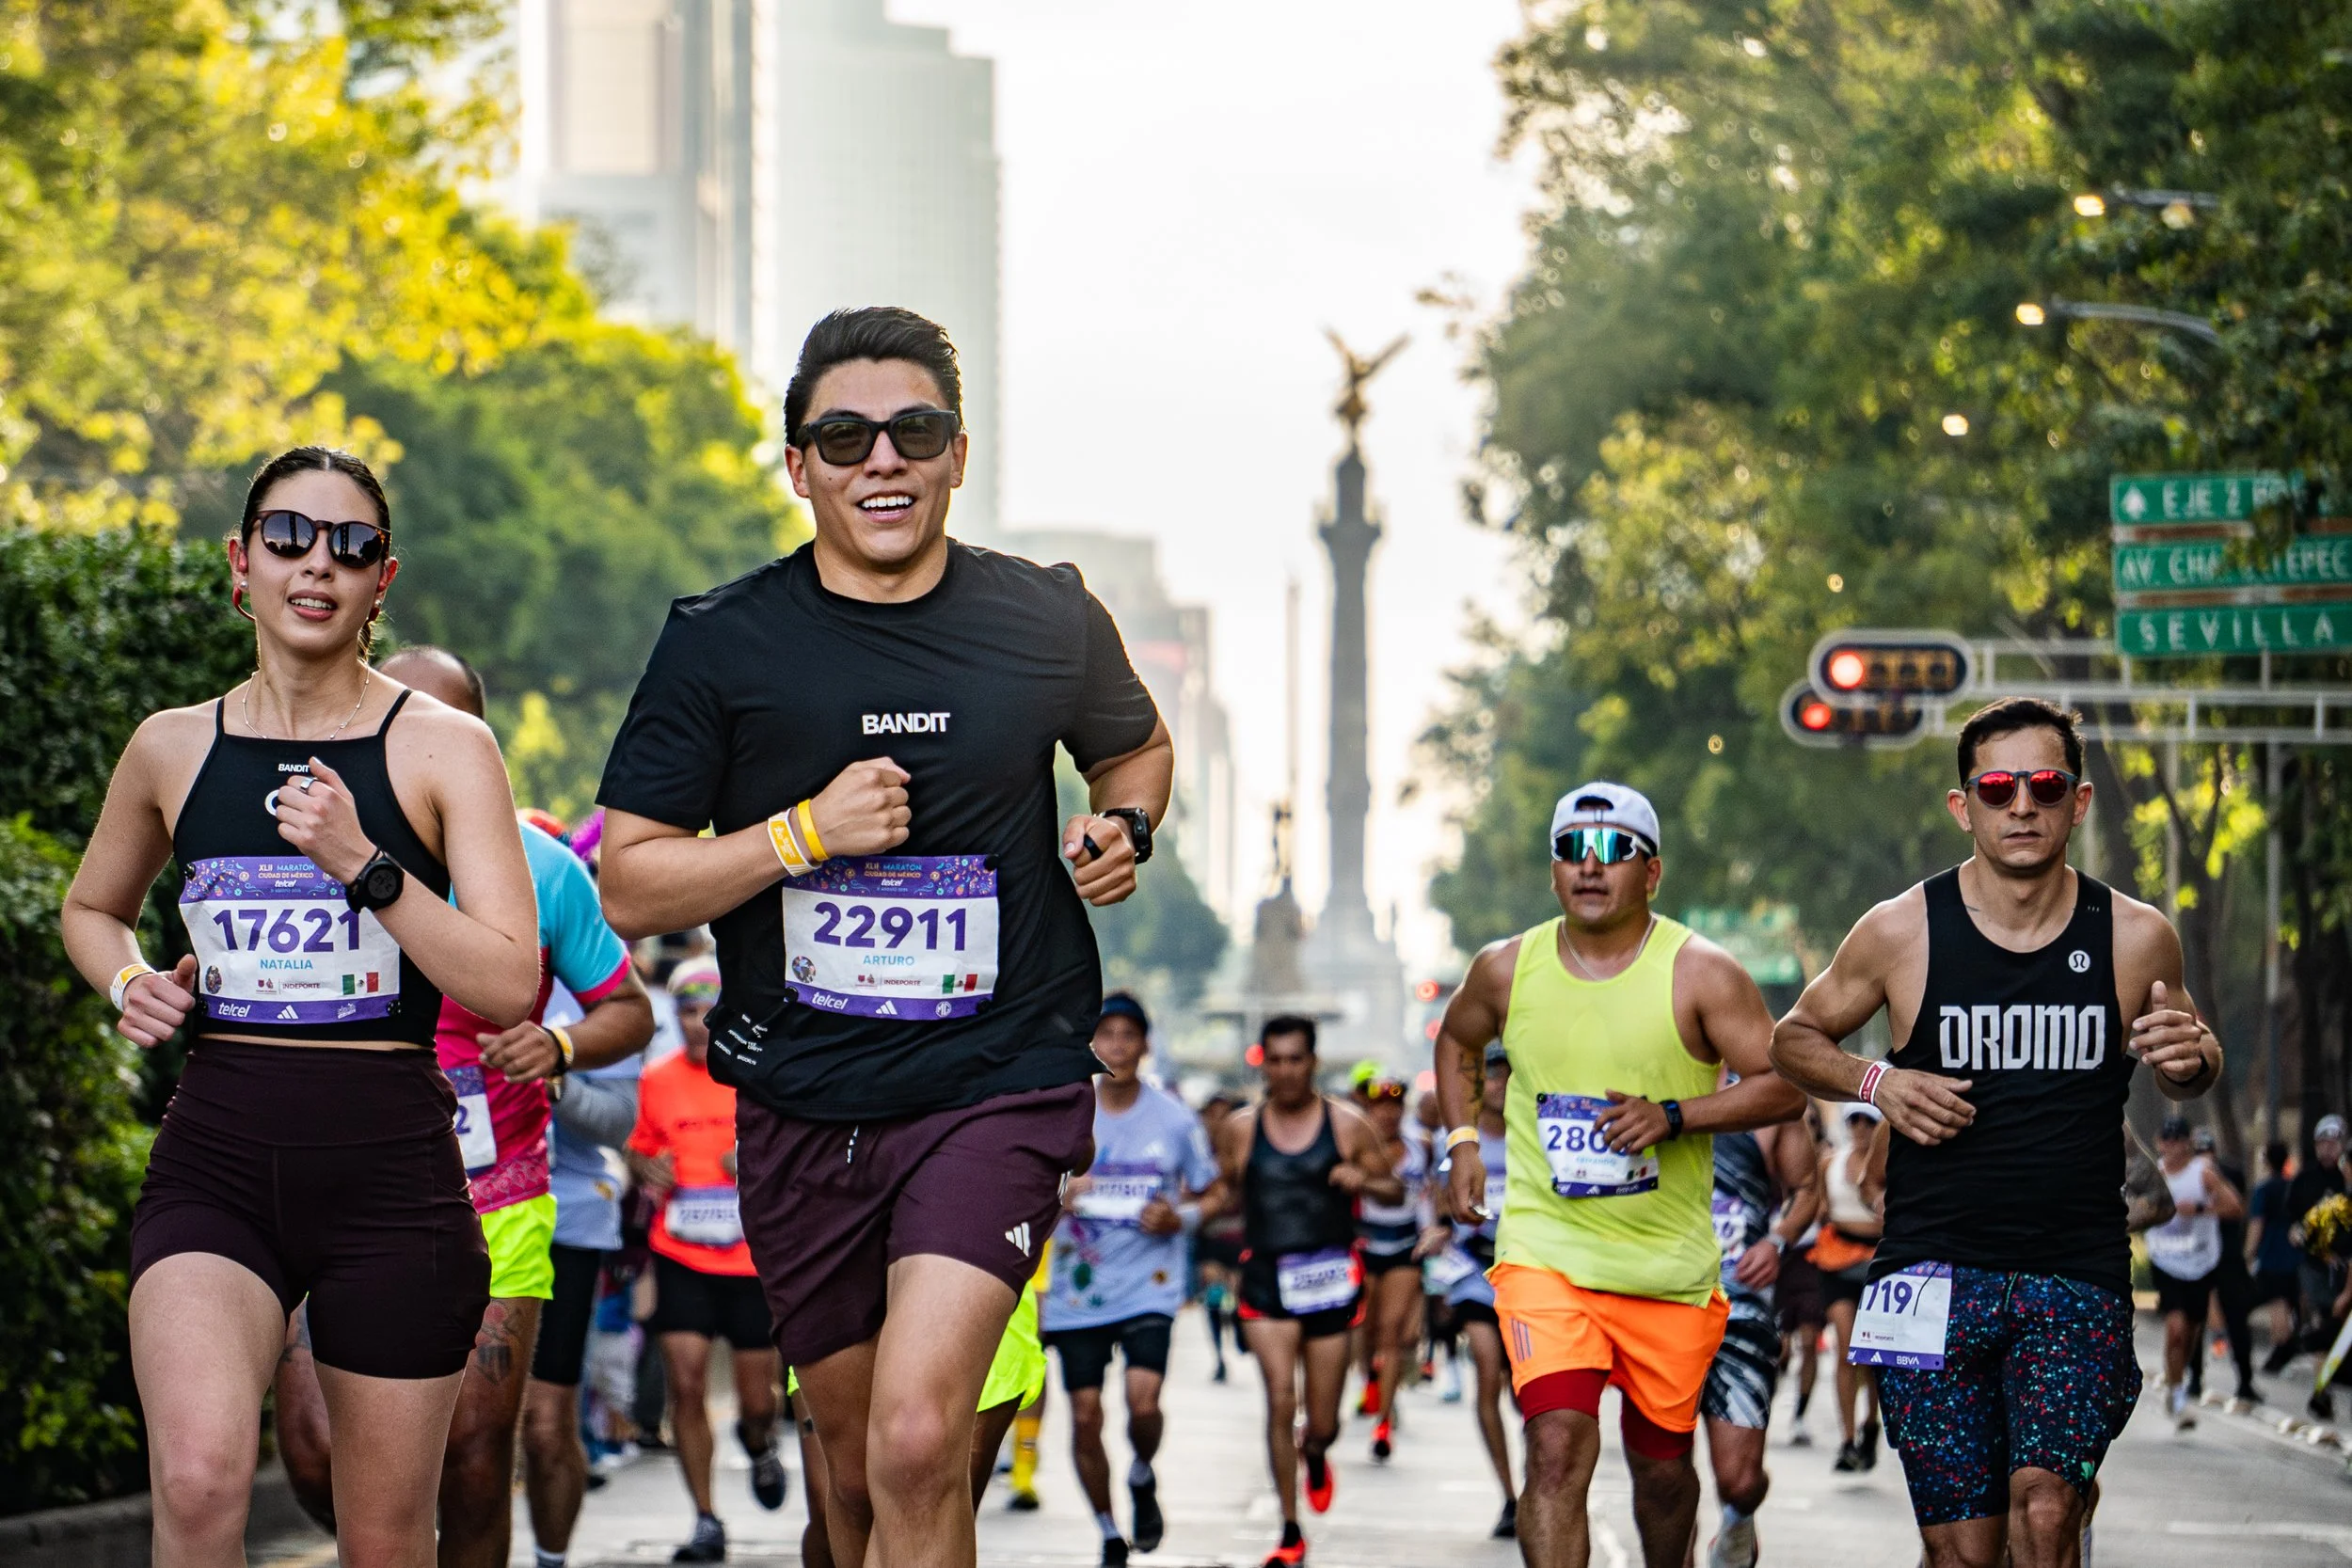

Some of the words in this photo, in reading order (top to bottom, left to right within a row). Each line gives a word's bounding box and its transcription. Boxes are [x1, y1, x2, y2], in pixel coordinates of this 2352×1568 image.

[2162, 479, 2216, 519] EJE
[2138, 609, 2335, 651] SEVILLA
[862, 712, 951, 735] BANDIT
[278, 763, 310, 773] BANDIT
[213, 909, 360, 954] 17621
[814, 901, 966, 951] 22911
[260, 958, 313, 971] NATALIA
[863, 955, 915, 966] ARTURO
[218, 1003, 251, 1018] telcel
[812, 991, 848, 1010] telcel
[1940, 1005, 2106, 1070] DROMO
[1548, 1125, 1628, 1158] 280
[1859, 1280, 1913, 1314] 719
[1896, 1354, 1919, 1365] BBVA
